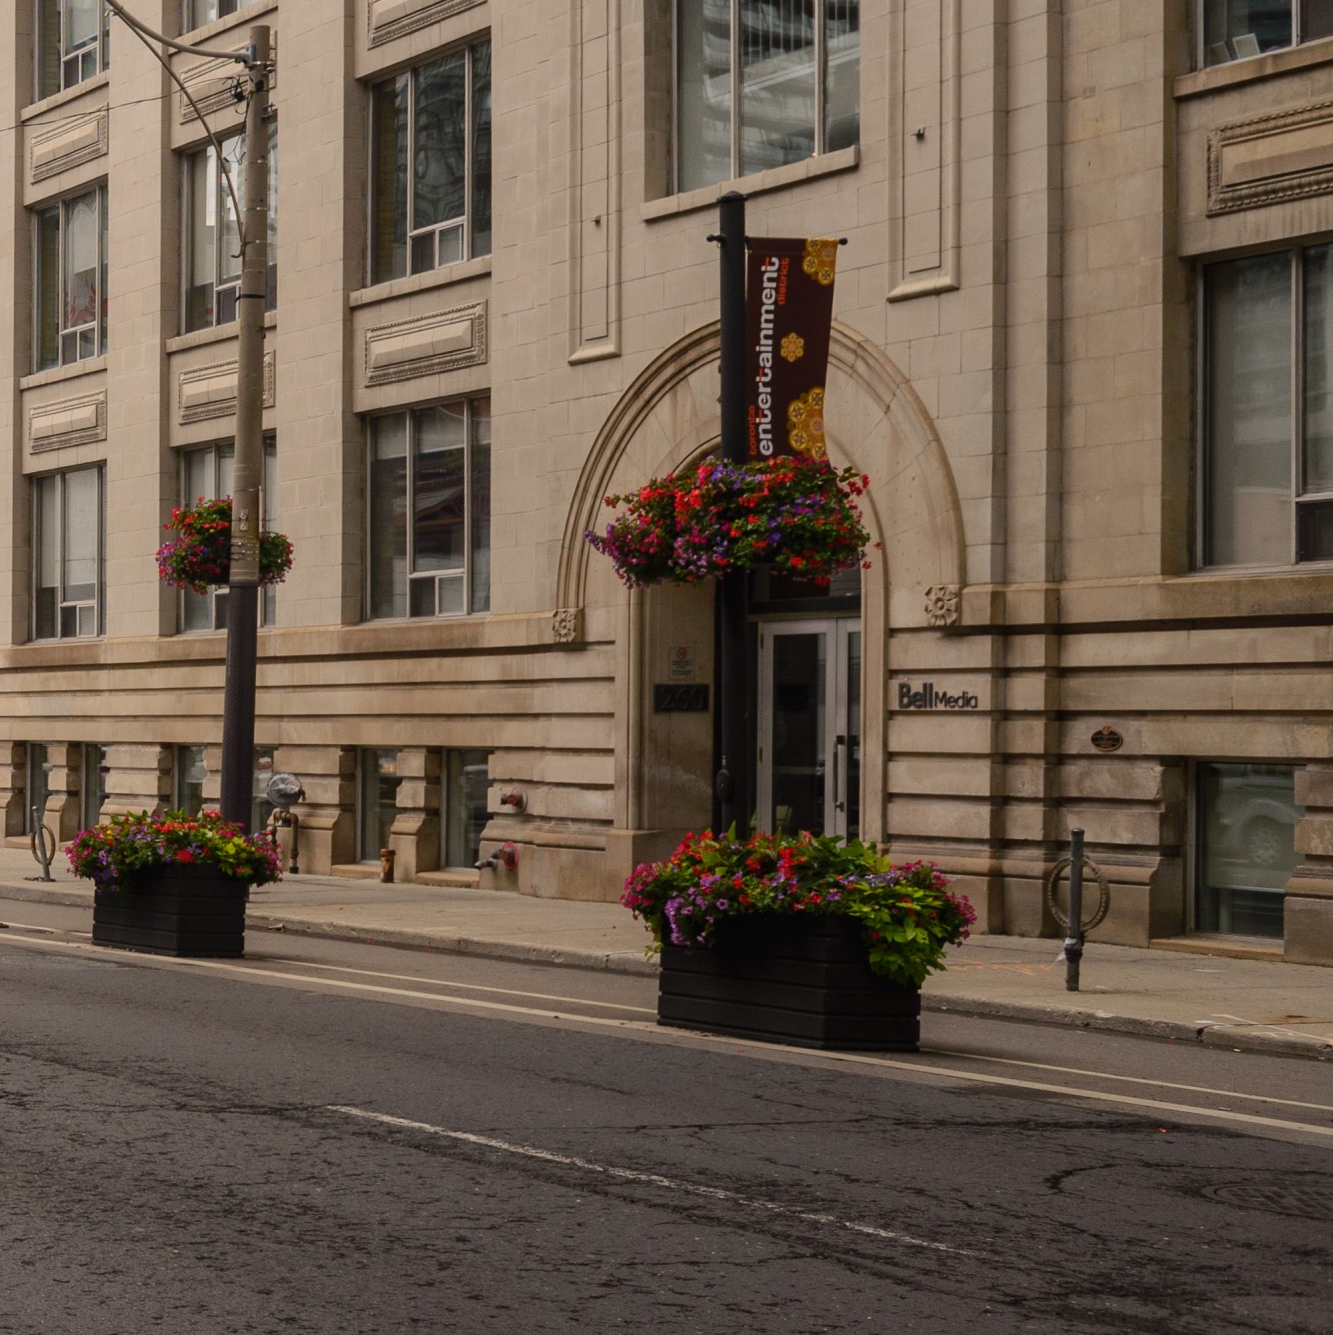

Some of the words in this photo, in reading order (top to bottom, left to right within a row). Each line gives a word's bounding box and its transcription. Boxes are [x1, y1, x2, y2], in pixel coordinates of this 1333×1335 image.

[777, 257, 790, 305] district
[755, 256, 780, 456] entertainment
[748, 404, 756, 456] toronto
[898, 682, 933, 709] Bell
[934, 690, 978, 709] Media
